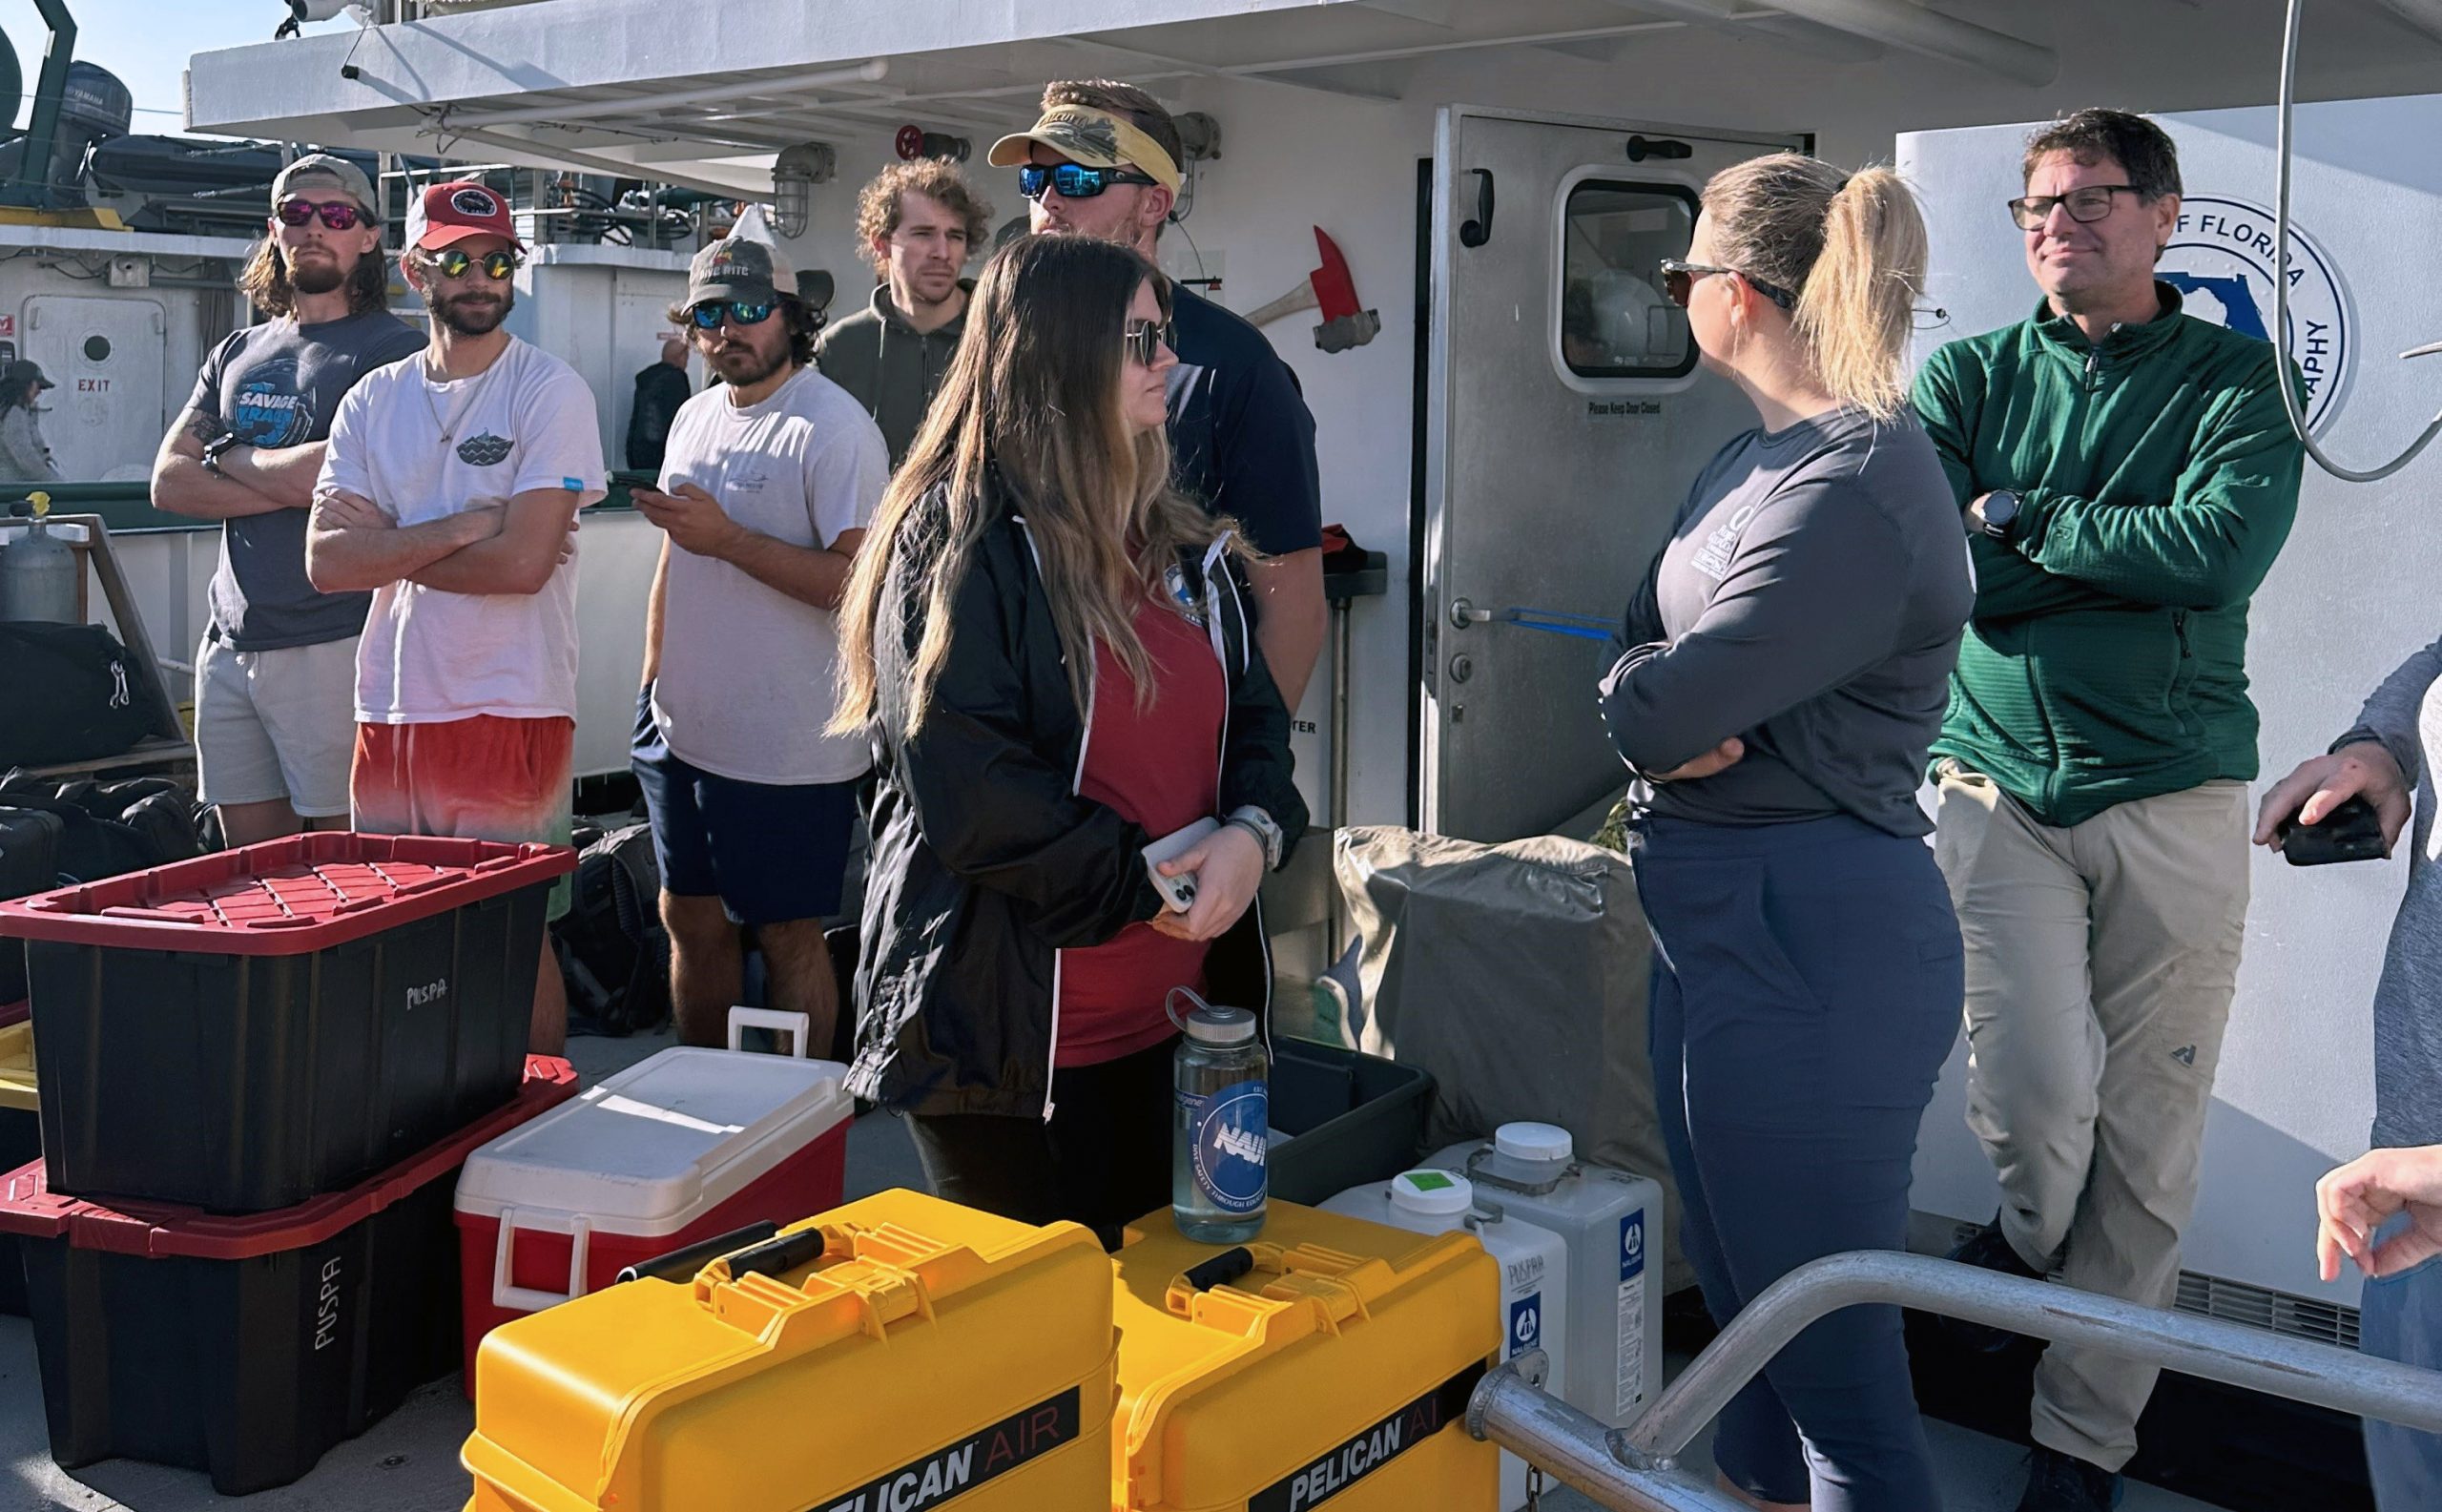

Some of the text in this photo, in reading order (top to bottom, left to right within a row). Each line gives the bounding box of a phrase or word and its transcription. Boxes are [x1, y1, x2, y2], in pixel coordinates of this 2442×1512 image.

[74, 88, 103, 105] YAMAHA
[78, 379, 111, 392] EXIT
[238, 391, 299, 410] SAVAGE
[1588, 402, 1660, 418] Please Keep Door Closed
[1293, 720, 1316, 734] TER
[406, 978, 447, 1011] PUSPA
[1211, 1190, 1245, 1208] THROUGH
[314, 1255, 342, 1350] PUSPA
[984, 1405, 1061, 1473] AIR
[1290, 1415, 1403, 1512] PELICAN
